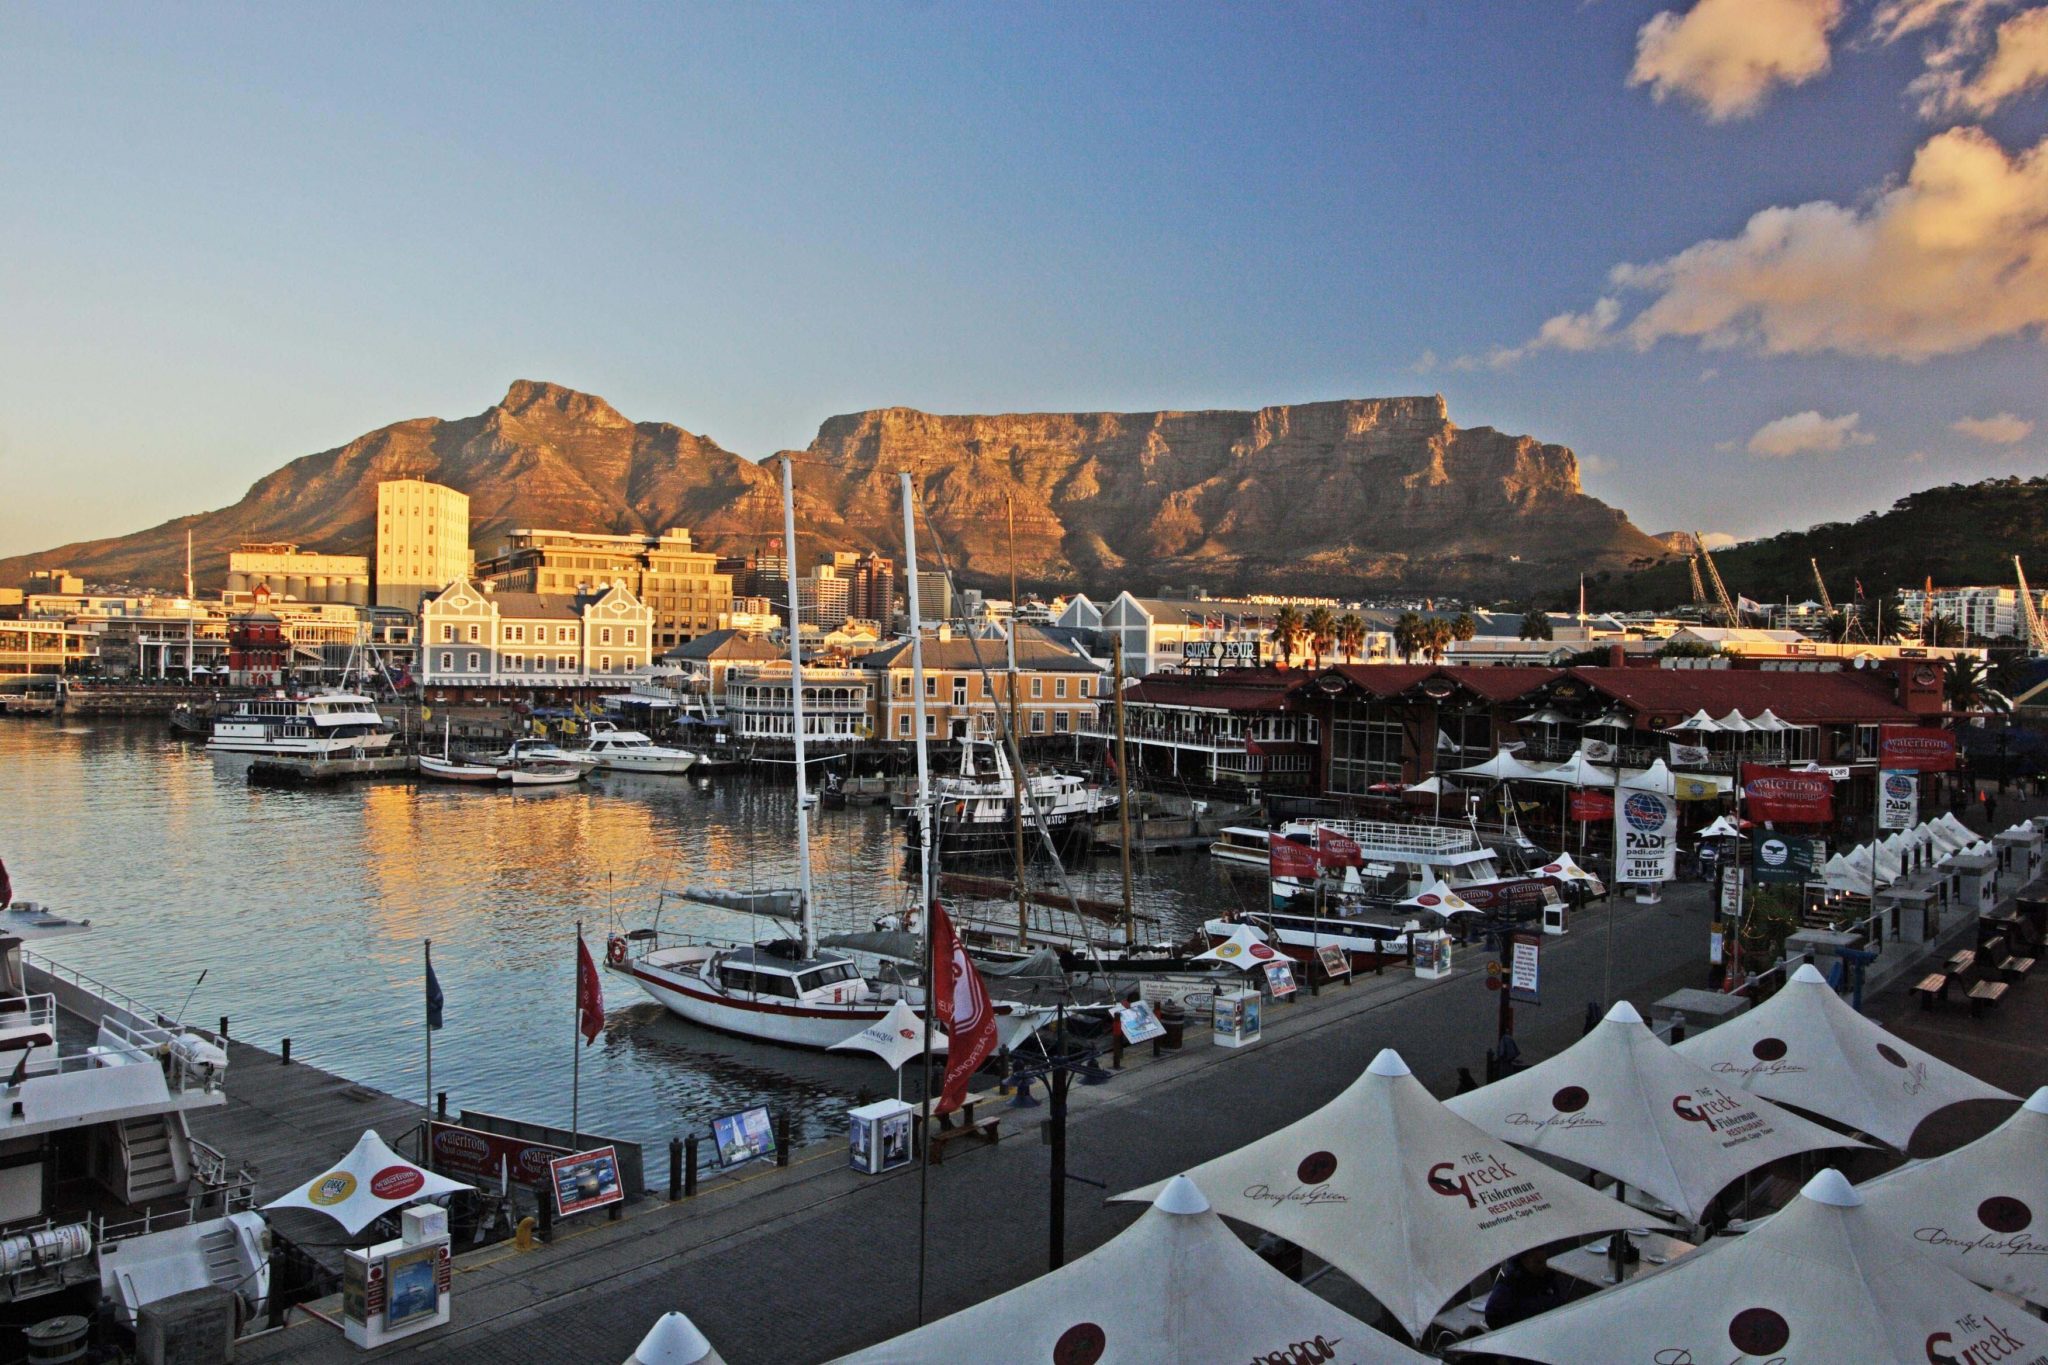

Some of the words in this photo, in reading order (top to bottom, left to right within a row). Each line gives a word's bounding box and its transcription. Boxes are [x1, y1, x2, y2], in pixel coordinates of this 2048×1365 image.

[1186, 642, 1211, 658] QUAY
[1226, 642, 1256, 658] FOUR
[1886, 800, 1911, 810] PADI
[1021, 816, 1039, 827] HAL
[1045, 815, 1067, 825] WATCH
[1626, 833, 1665, 849] PADI
[1635, 860, 1658, 868] DIVE
[1711, 1061, 1769, 1077] Douglas
[1770, 1060, 1807, 1075] Green
[1696, 1087, 1713, 1098] THE
[1672, 1089, 1741, 1133] Greek
[1715, 1111, 1758, 1129] Fisherman
[1504, 1112, 1565, 1131] Douglas
[1567, 1112, 1608, 1130] Green
[1726, 1120, 1766, 1137] RESTAURANT
[440, 1132, 486, 1152] waterfront
[1462, 1152, 1484, 1165] THE
[1427, 1154, 1517, 1209] Greek
[1243, 1183, 1307, 1207] Douglas
[1309, 1183, 1350, 1207] Green
[1478, 1182, 1535, 1205] Fisherman
[1488, 1192, 1543, 1215] RESTAURANT
[1478, 1214, 1517, 1230] Waterfront,
[1515, 1208, 1534, 1219] Cape
[1533, 1203, 1551, 1213] Town
[1913, 1227, 2003, 1255] Douglas
[2005, 1233, 2048, 1257] Gree
[1955, 1313, 1981, 1334] THE
